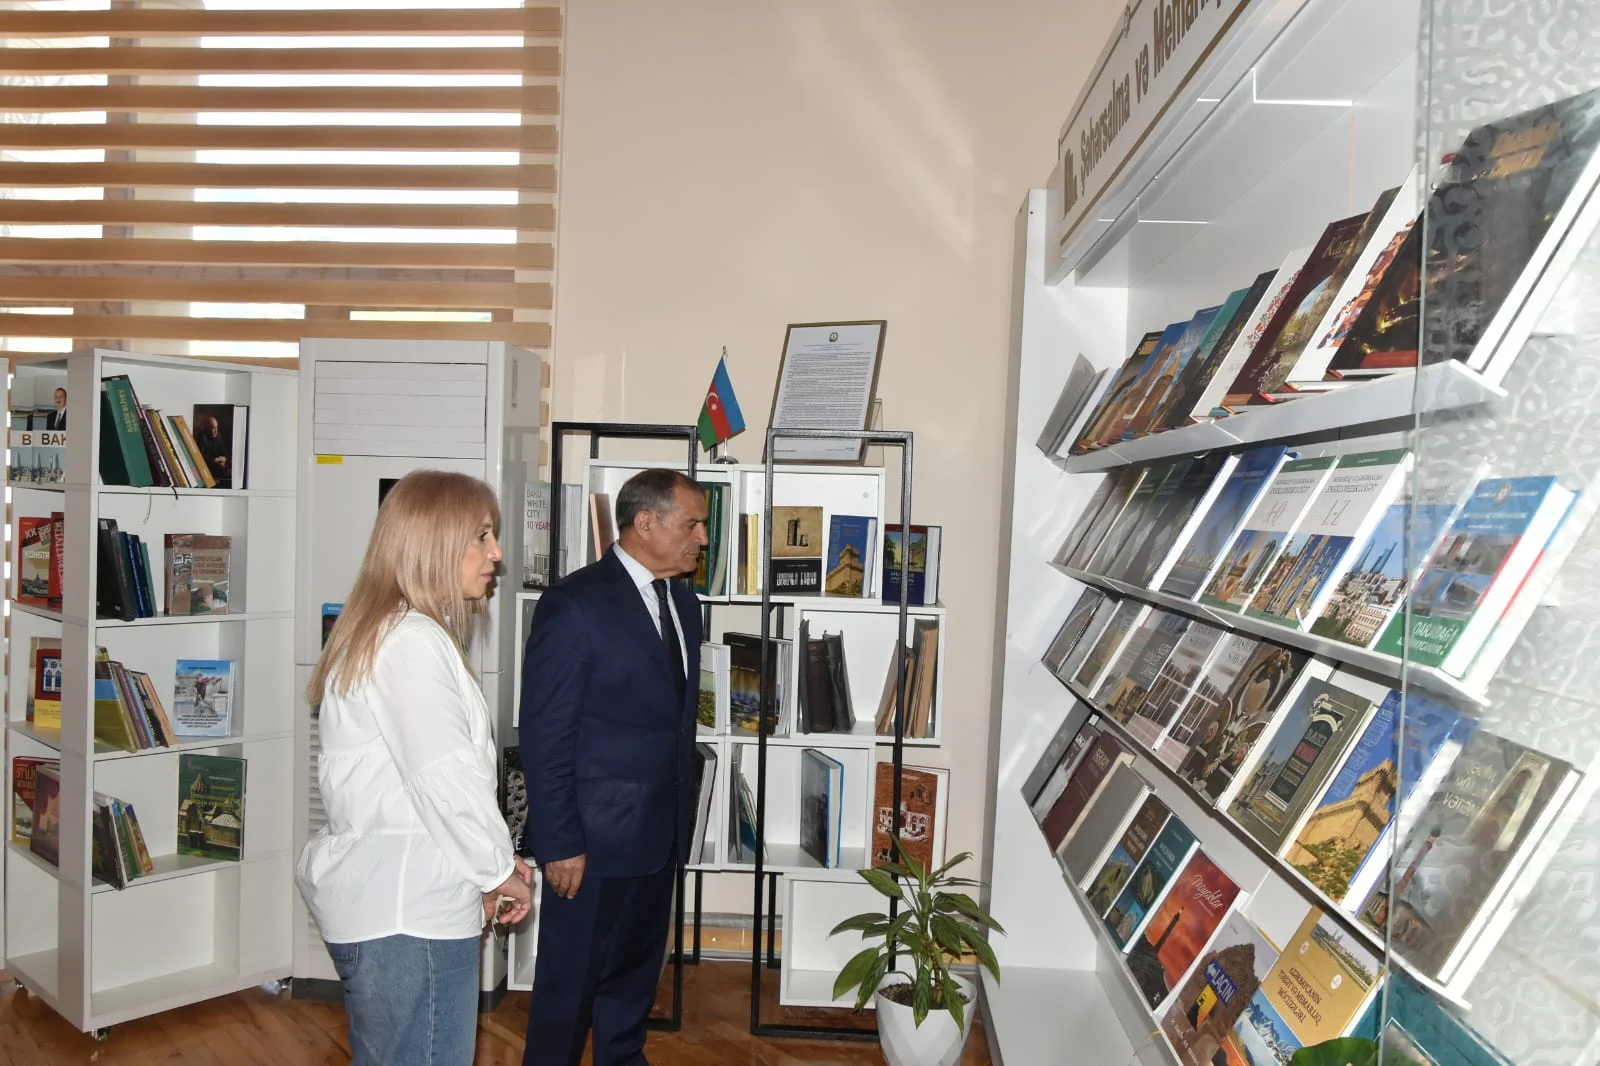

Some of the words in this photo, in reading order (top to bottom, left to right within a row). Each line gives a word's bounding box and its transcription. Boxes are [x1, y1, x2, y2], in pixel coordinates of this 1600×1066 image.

[1135, 43, 1149, 105] və
[526, 488, 542, 498] BAKU
[526, 500, 546, 509] WHITE
[526, 509, 541, 518] CITY
[527, 521, 534, 530] 10
[1211, 968, 1236, 1003] LAÇIN
